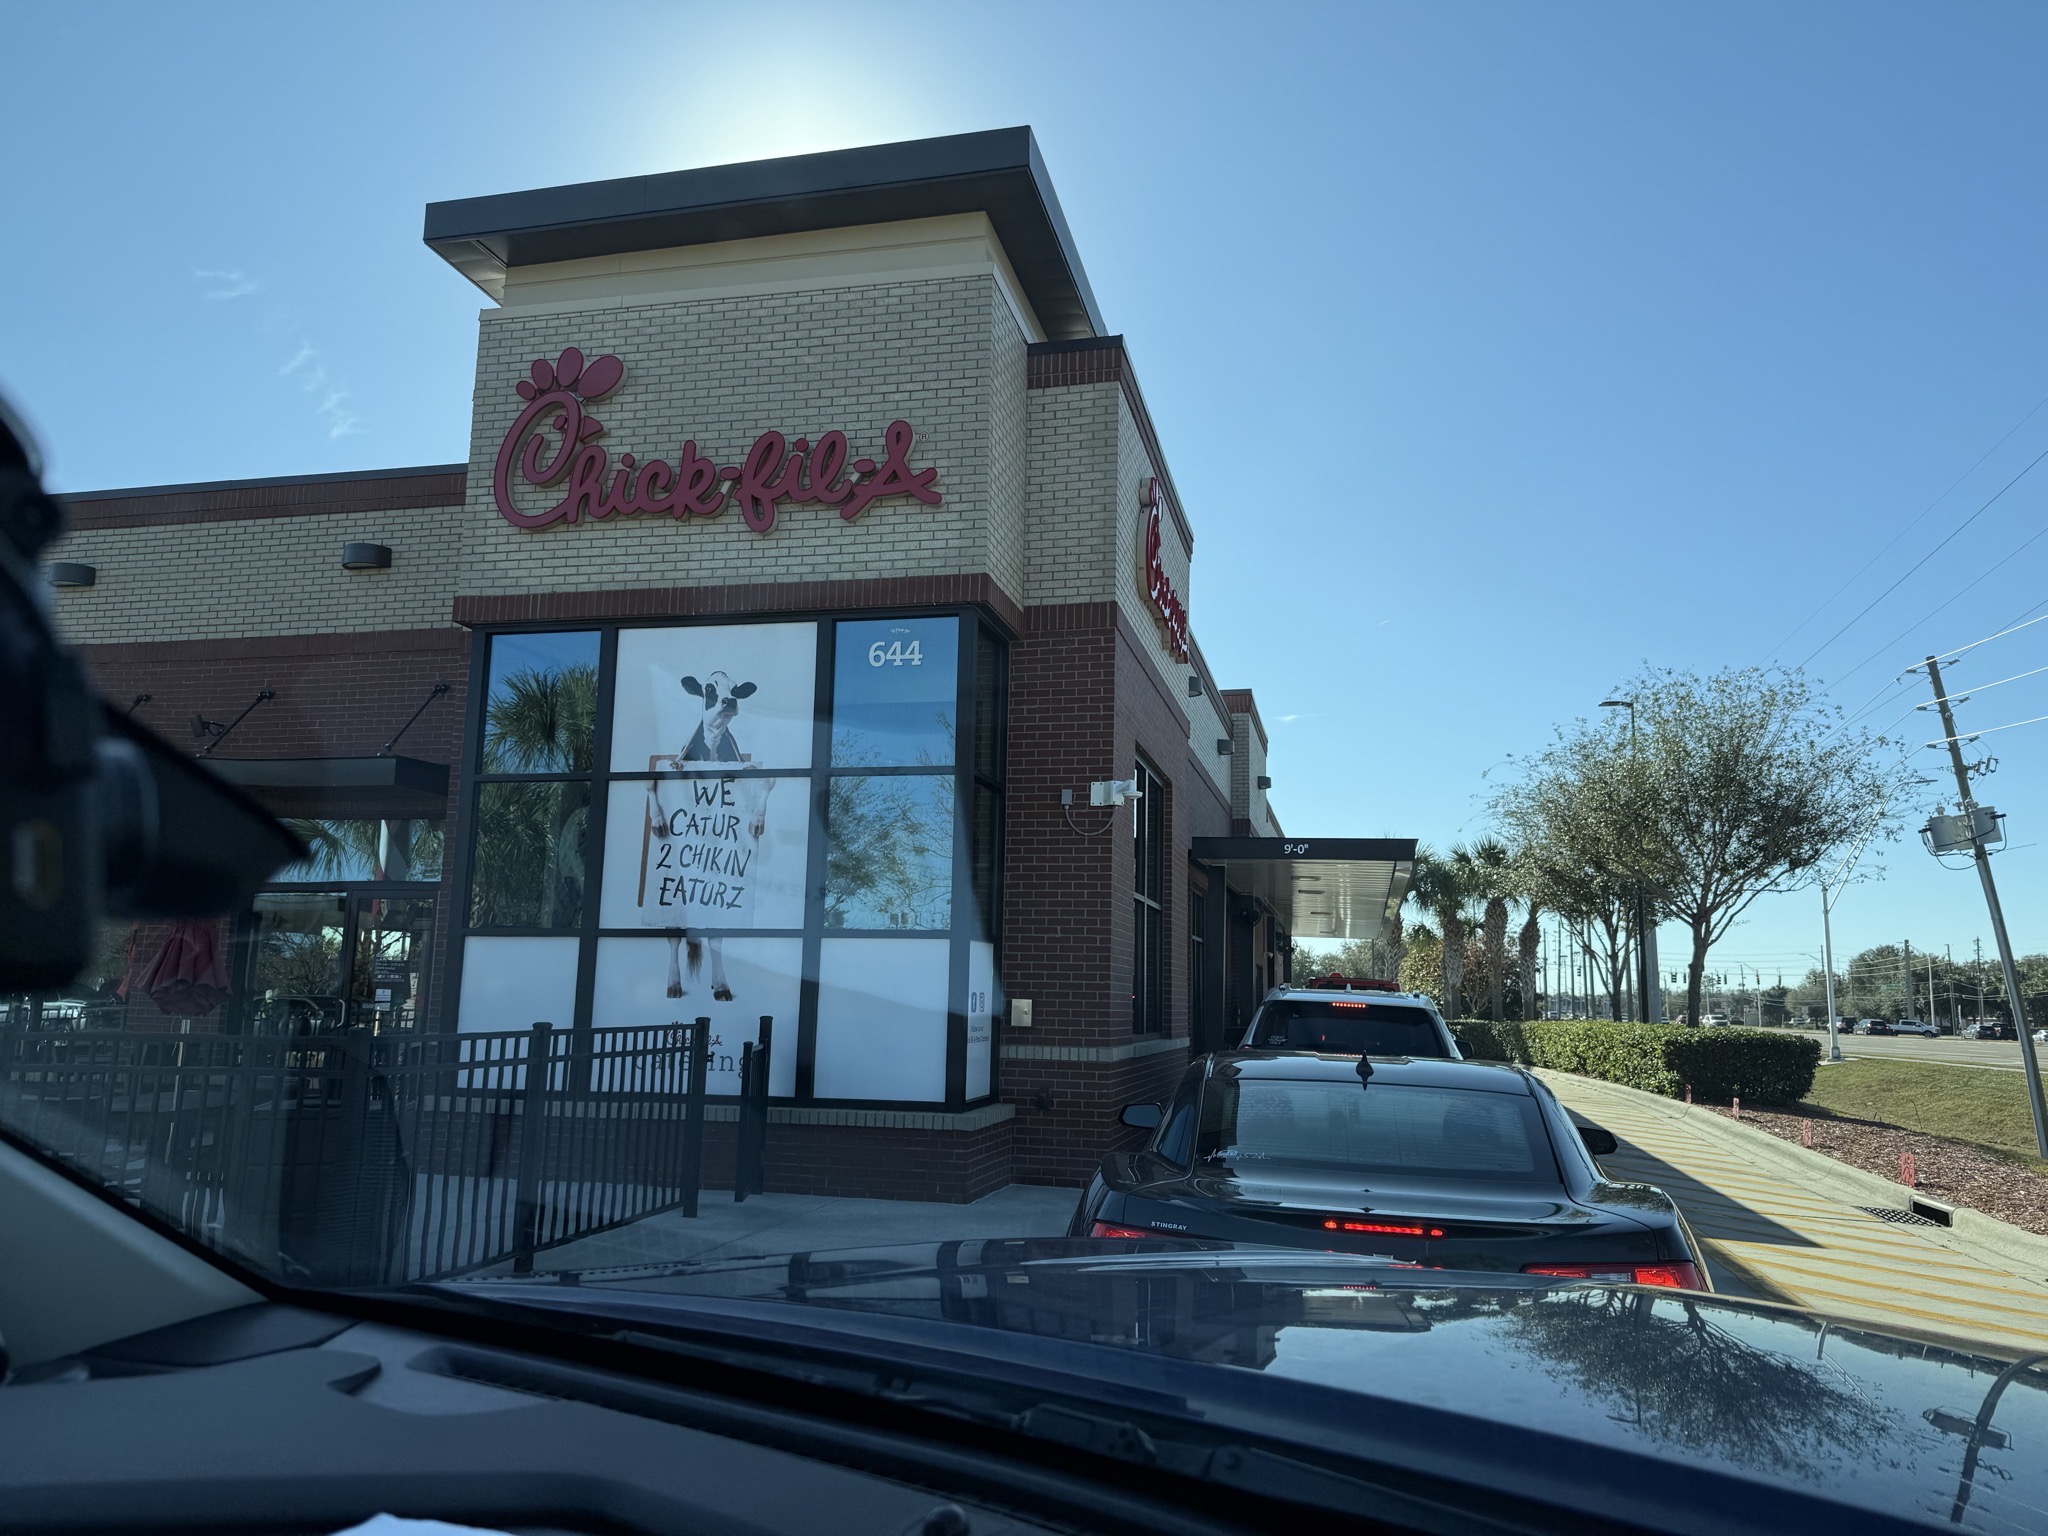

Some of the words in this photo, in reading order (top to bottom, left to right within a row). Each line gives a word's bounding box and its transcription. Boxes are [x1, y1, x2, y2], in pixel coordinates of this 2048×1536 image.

[494, 347, 943, 535] Chick-fil-A
[869, 641, 923, 667] 644
[693, 778, 736, 808] WE
[669, 808, 740, 843] CATUR
[656, 843, 672, 870] 2
[679, 843, 751, 878] CHIKIN
[1284, 843, 1309, 855] 9'-0"
[659, 875, 745, 909] EATURZ
[1151, 1221, 1187, 1231] STINGRAY
